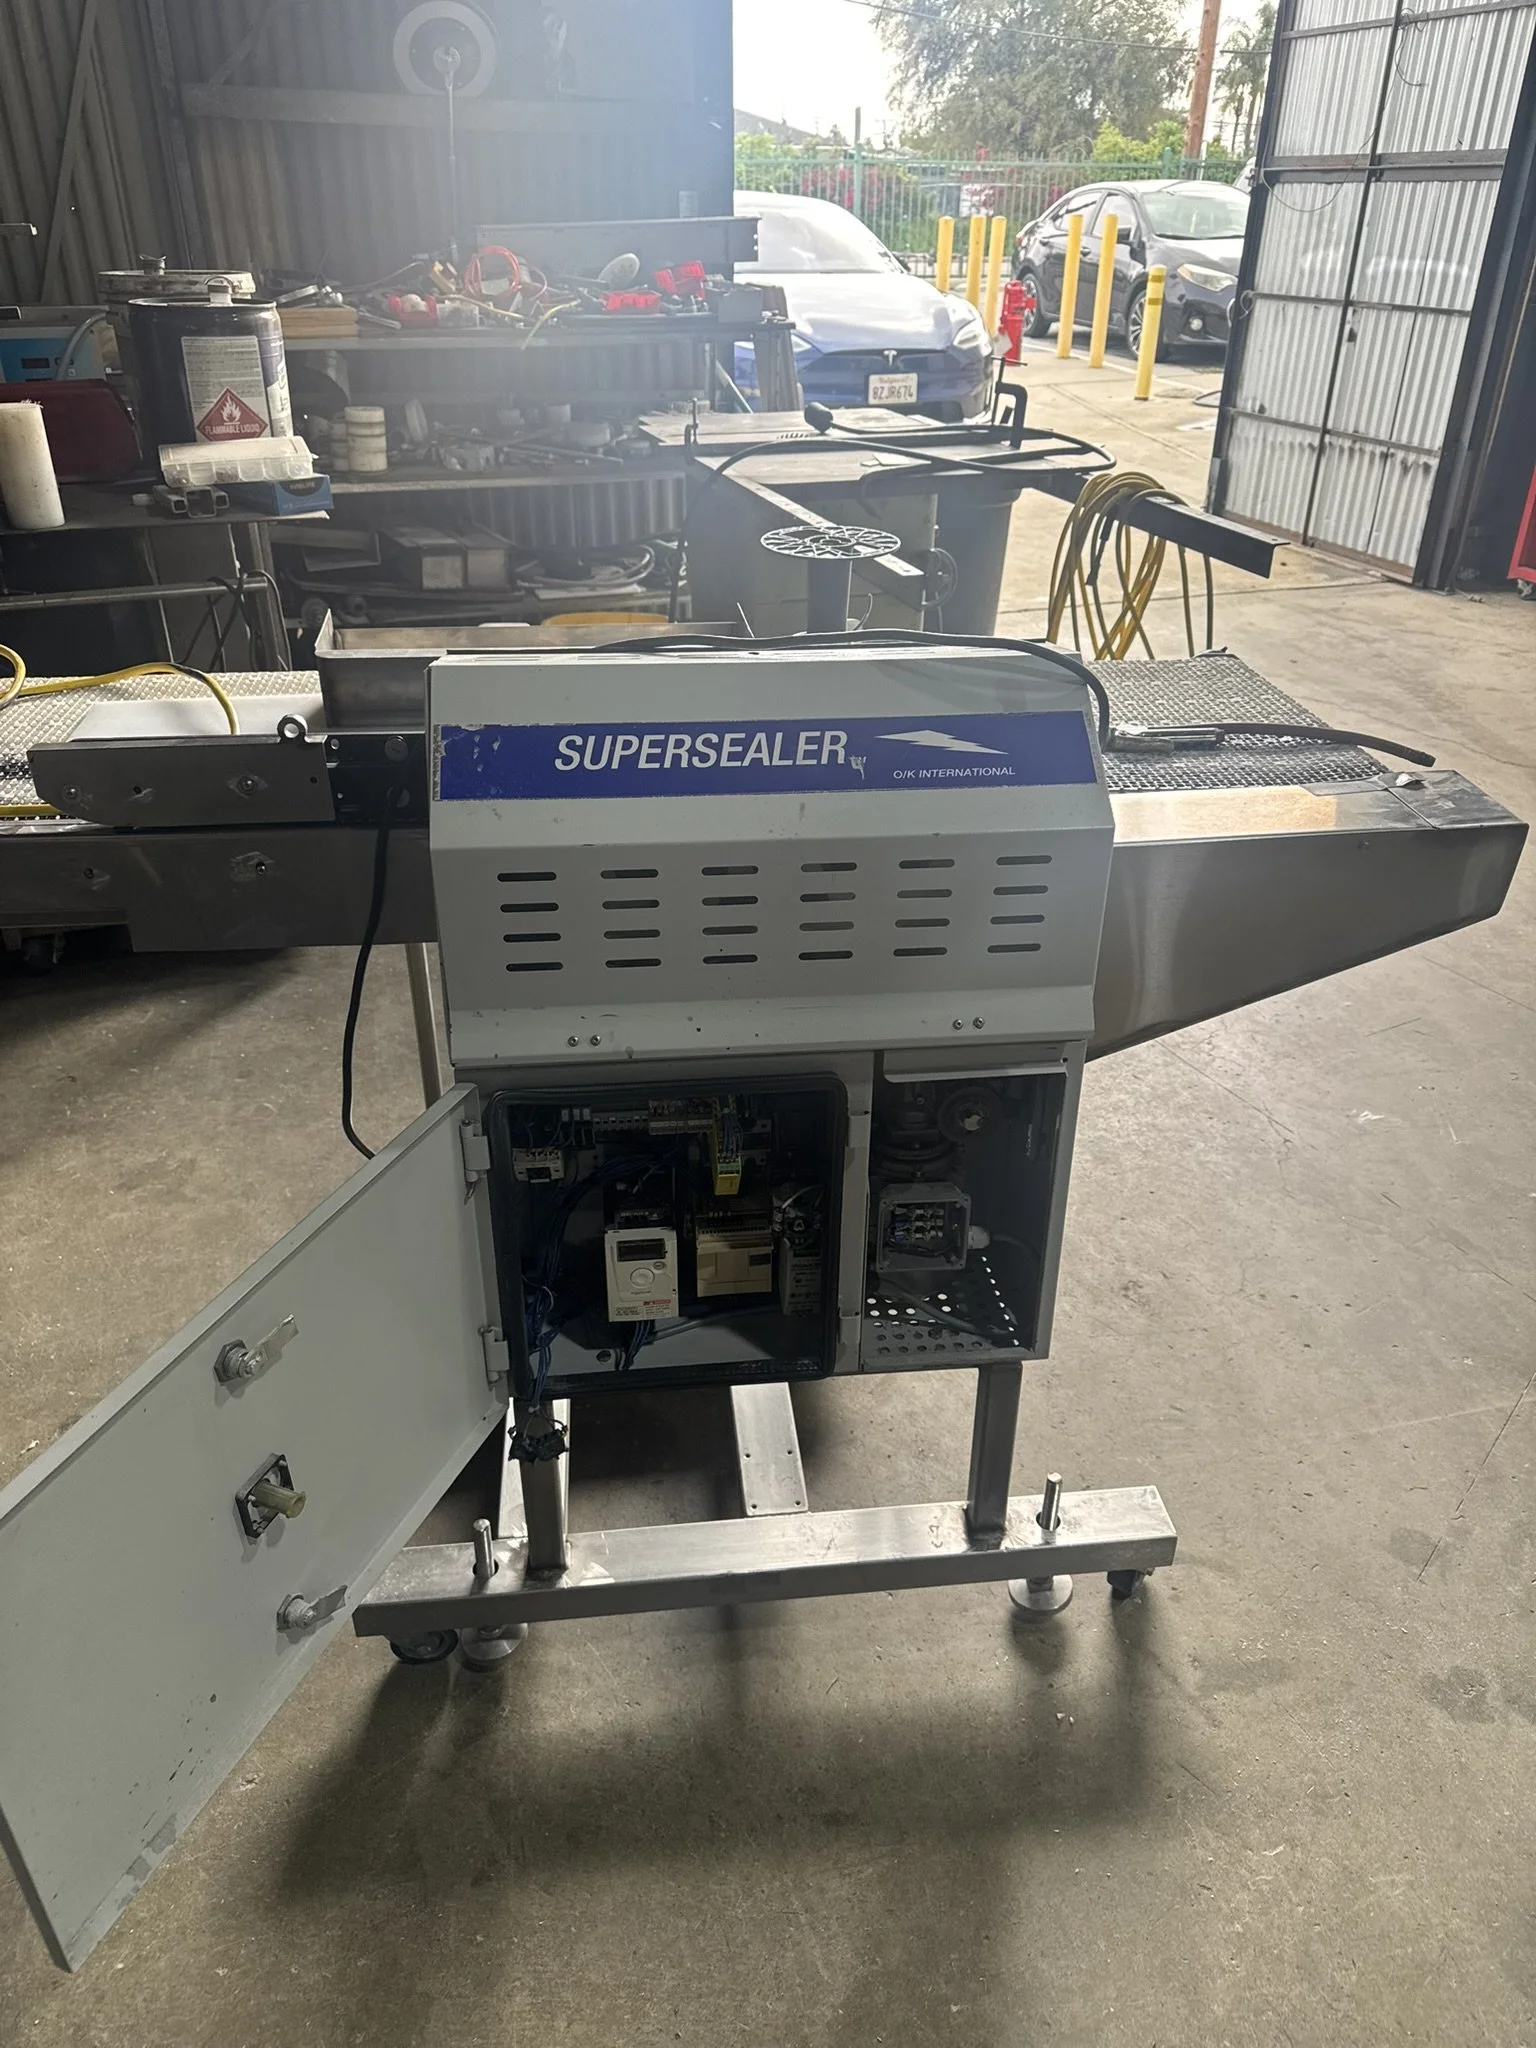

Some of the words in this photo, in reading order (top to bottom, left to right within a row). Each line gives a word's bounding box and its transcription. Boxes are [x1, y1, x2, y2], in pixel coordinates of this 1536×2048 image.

[204, 424, 240, 434] FLAMMABLE
[241, 423, 260, 433] LIQUID
[554, 730, 848, 771] SUPERSEALER
[893, 769, 916, 779] O/K
[918, 766, 1016, 778] INTERNATIONAL
